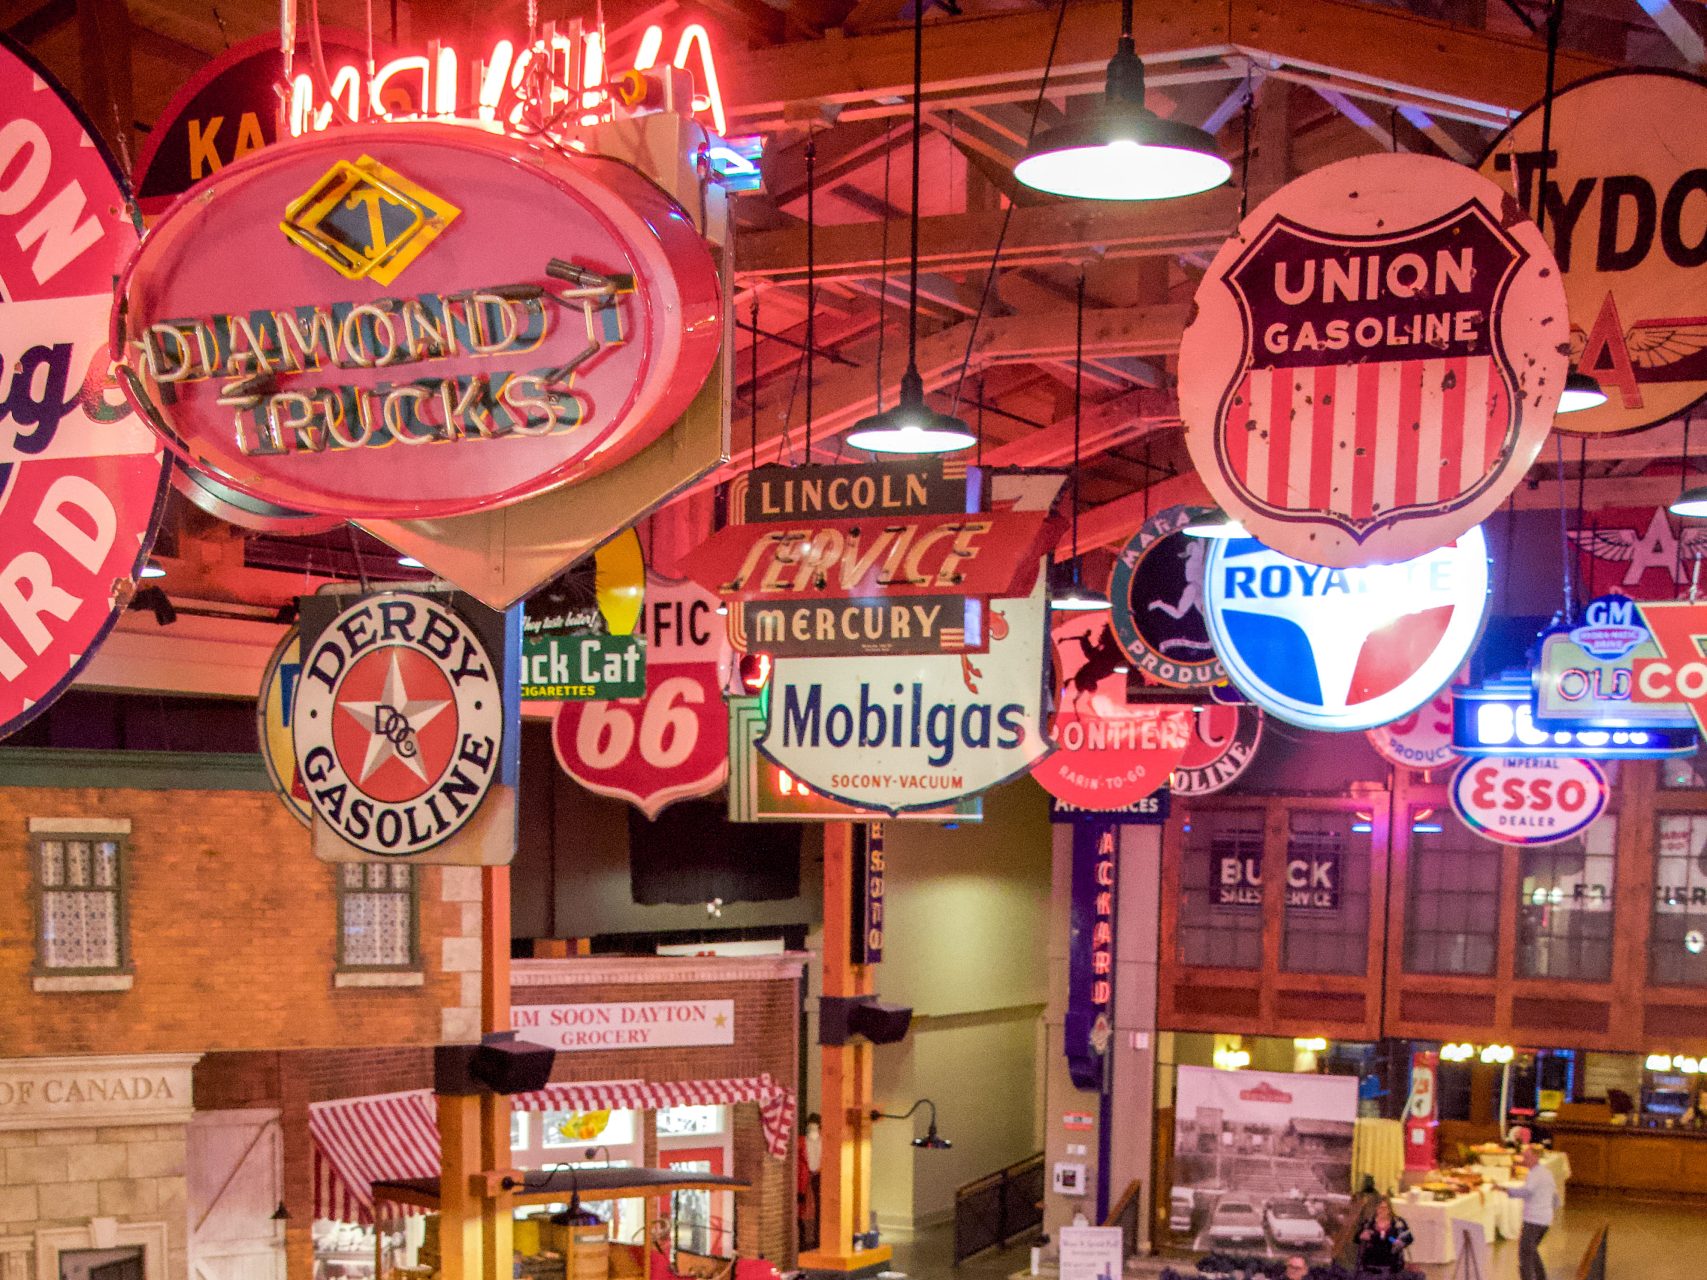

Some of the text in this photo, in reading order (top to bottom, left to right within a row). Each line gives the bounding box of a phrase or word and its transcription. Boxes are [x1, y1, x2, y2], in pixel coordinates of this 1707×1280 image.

[1495, 149, 1707, 273] TYDO
[1274, 248, 1474, 306] UNION
[141, 286, 548, 382] DIAMOND
[1264, 311, 1479, 354] GASOLINE
[218, 368, 584, 455] TRUCKS
[761, 473, 927, 514] LINCOLN
[719, 521, 992, 594] SERVICE
[755, 605, 942, 642] MERCURY
[1586, 601, 1633, 626] GM
[307, 601, 489, 694] DERBY
[581, 640, 640, 683] Cat
[1127, 639, 1226, 682] PRODUC
[576, 677, 705, 770] 66
[783, 682, 1025, 766] Mobilgas
[831, 775, 963, 789] SOCONY-VACUUM
[1174, 741, 1250, 791] OLINE
[1503, 758, 1559, 769] IMPERIAL
[303, 733, 495, 847] GASOLINE
[1499, 816, 1555, 827] DEALER
[1221, 858, 1332, 888] BUCK
[551, 1008, 611, 1026] SOON
[621, 1005, 707, 1023] DAYTON
[561, 1029, 651, 1045] GROCERY
[43, 1076, 174, 1104] CANADA
